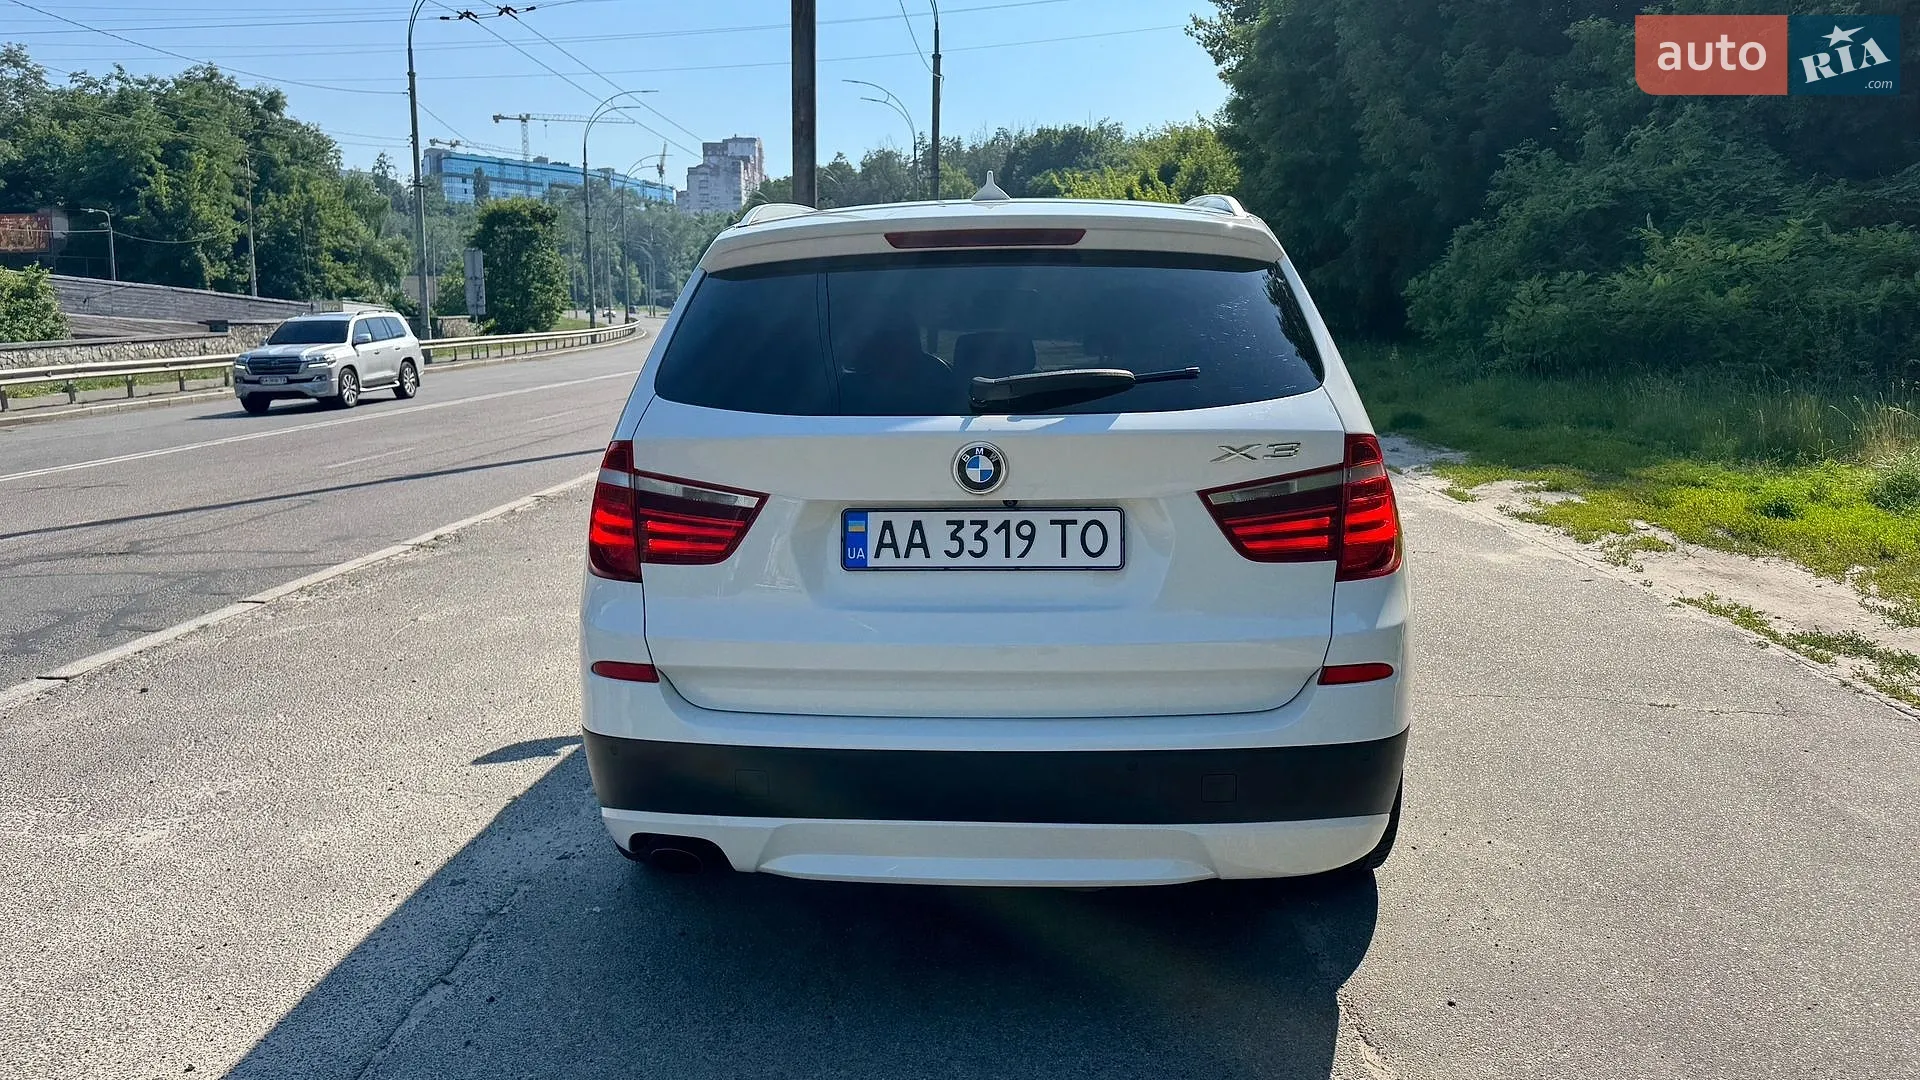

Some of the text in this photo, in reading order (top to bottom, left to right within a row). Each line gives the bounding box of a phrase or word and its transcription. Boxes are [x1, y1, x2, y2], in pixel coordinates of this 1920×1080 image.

[961, 447, 999, 463] BMW
[1209, 442, 1301, 462] X3
[874, 519, 1108, 558] AA 3319 TO
[847, 547, 865, 559] UA
